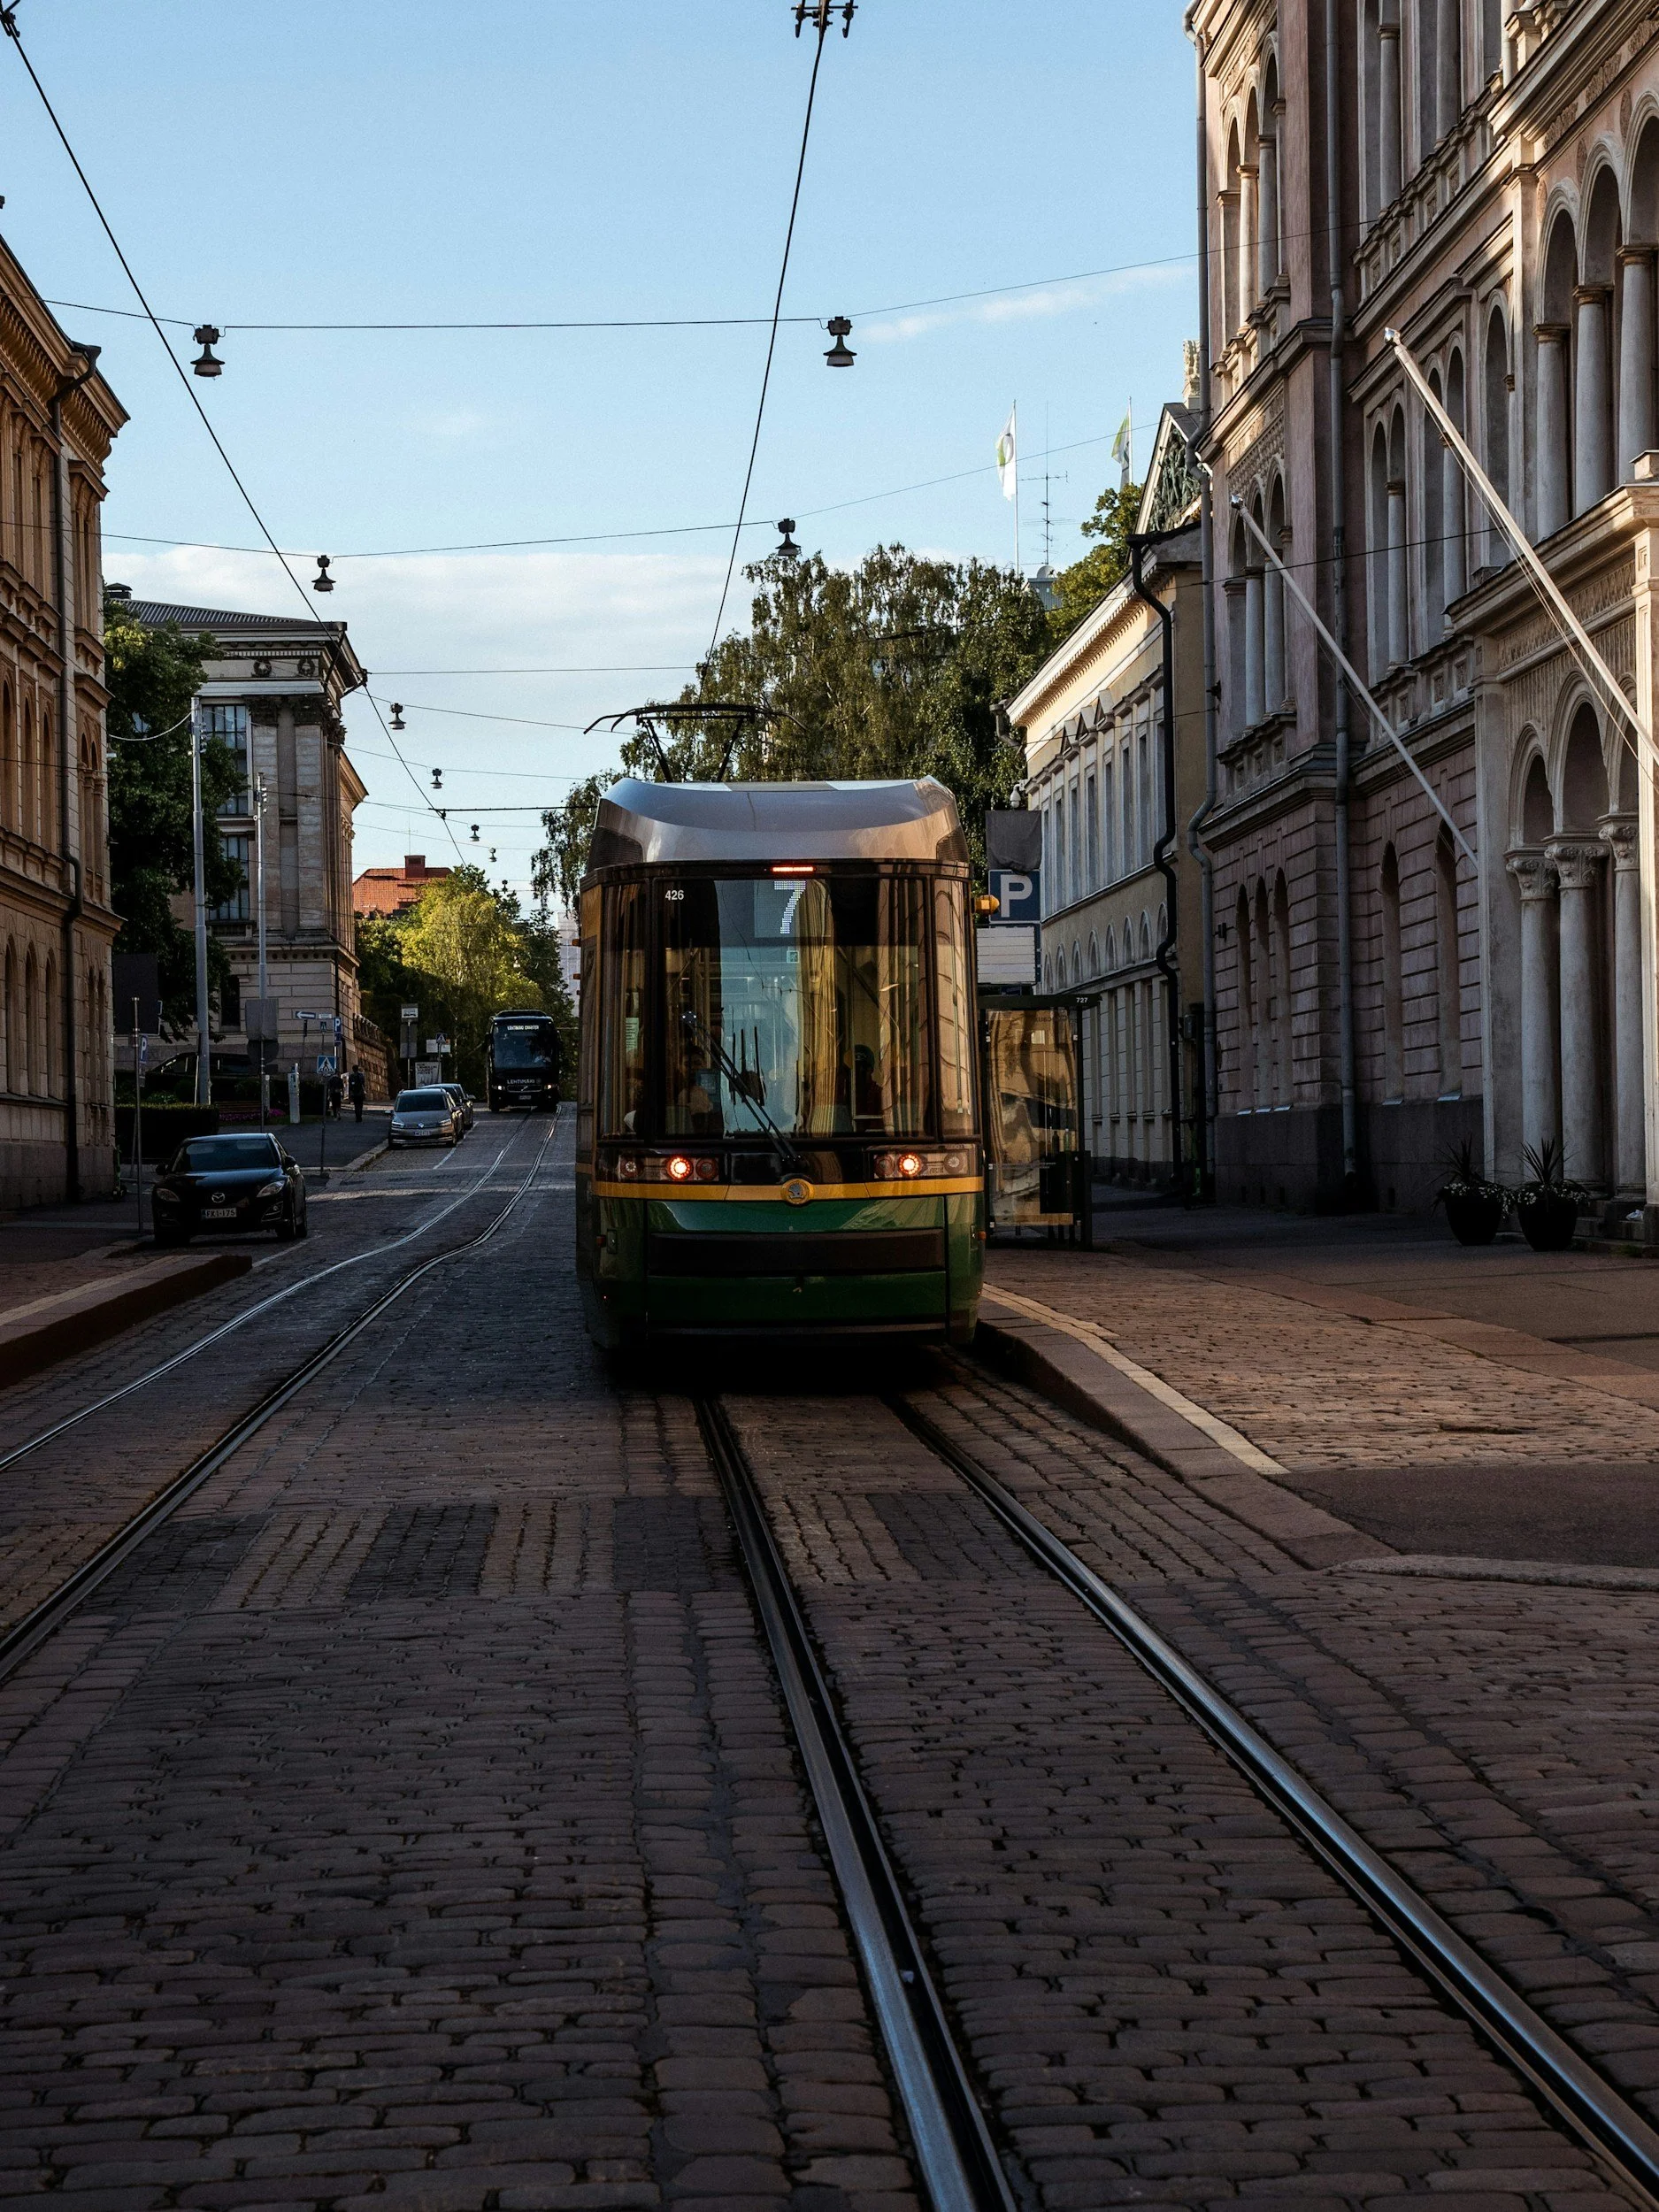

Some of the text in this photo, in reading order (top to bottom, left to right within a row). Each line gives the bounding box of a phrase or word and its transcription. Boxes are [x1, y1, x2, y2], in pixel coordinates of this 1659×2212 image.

[664, 889, 685, 901] 426
[774, 880, 806, 934] 7
[1000, 873, 1033, 918] P
[334, 1018, 342, 1032] P
[141, 1036, 147, 1060] P
